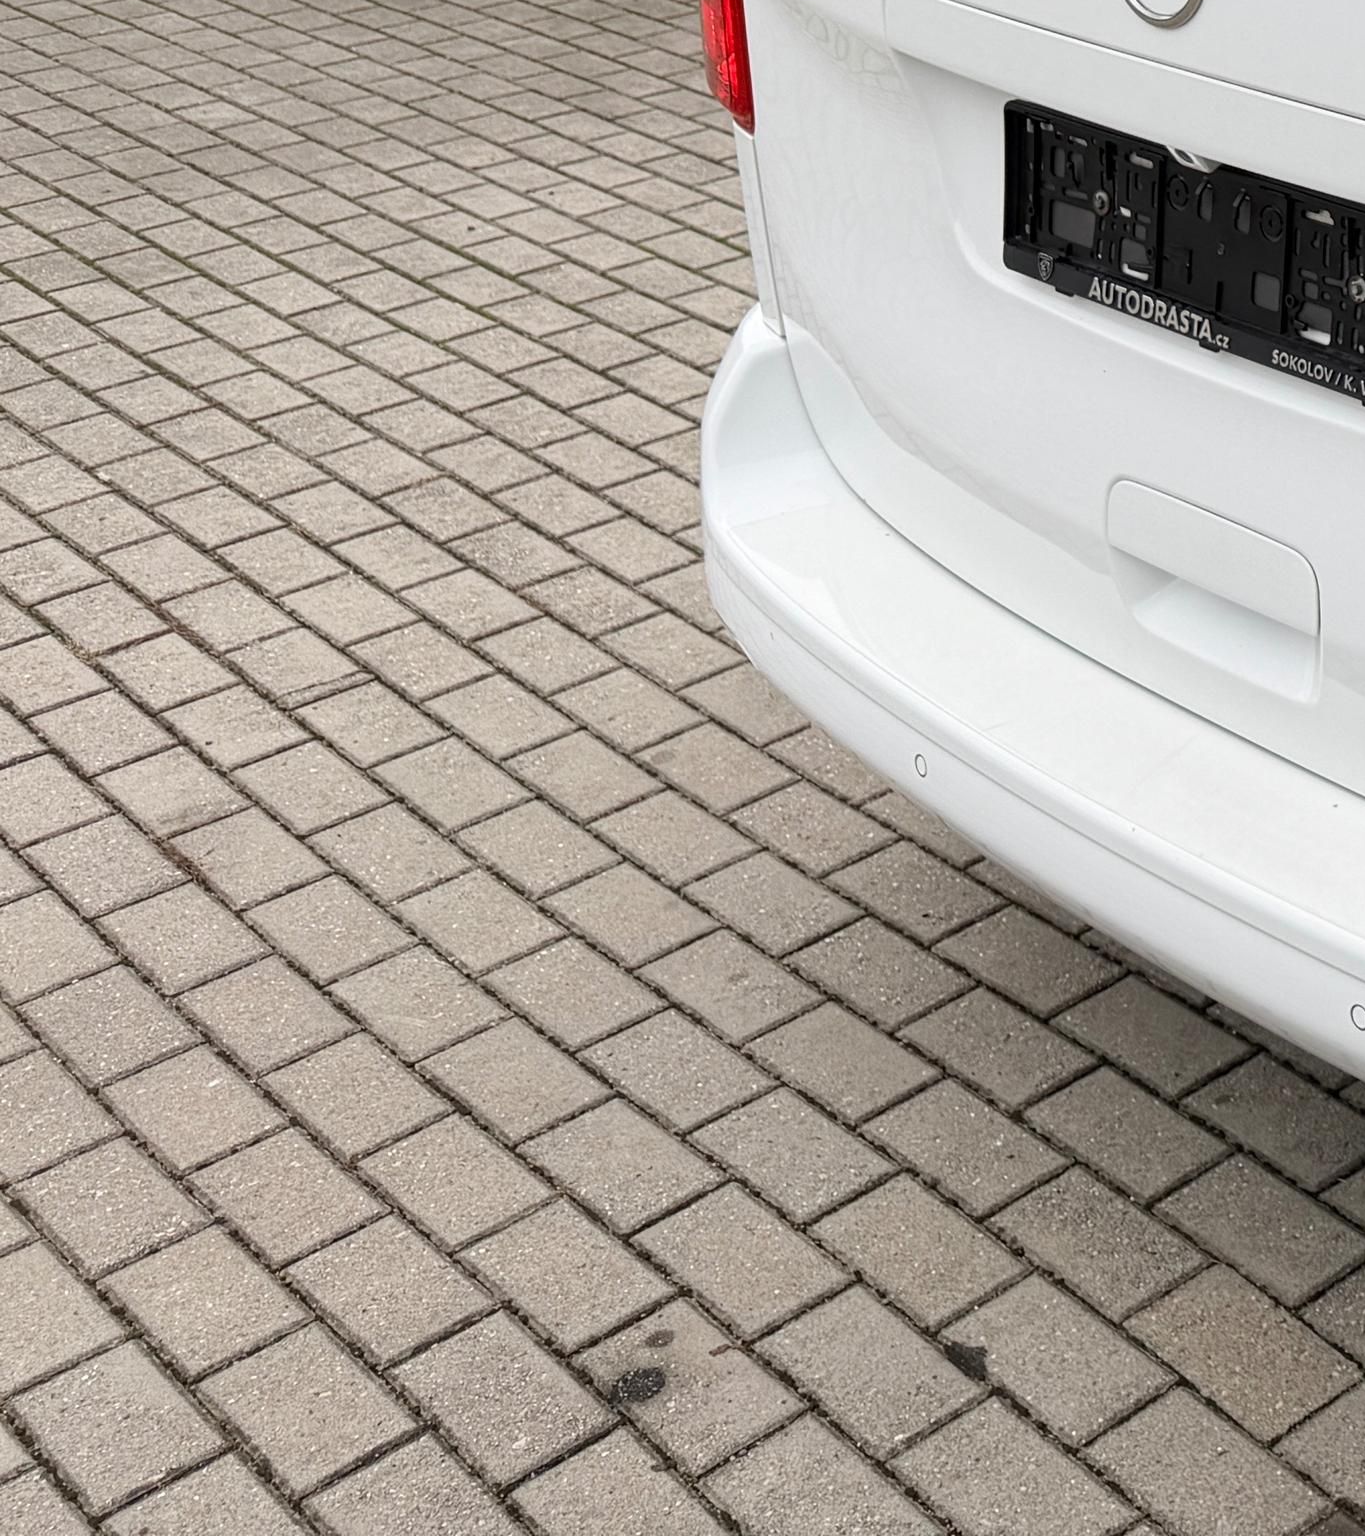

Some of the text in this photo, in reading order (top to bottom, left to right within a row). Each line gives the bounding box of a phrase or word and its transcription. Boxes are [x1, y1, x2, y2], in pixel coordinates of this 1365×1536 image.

[1087, 275, 1230, 350] AUTODRASTA.cz
[1271, 348, 1333, 385] SOKOLOV
[1333, 372, 1342, 388] /
[1343, 373, 1358, 394] K.
